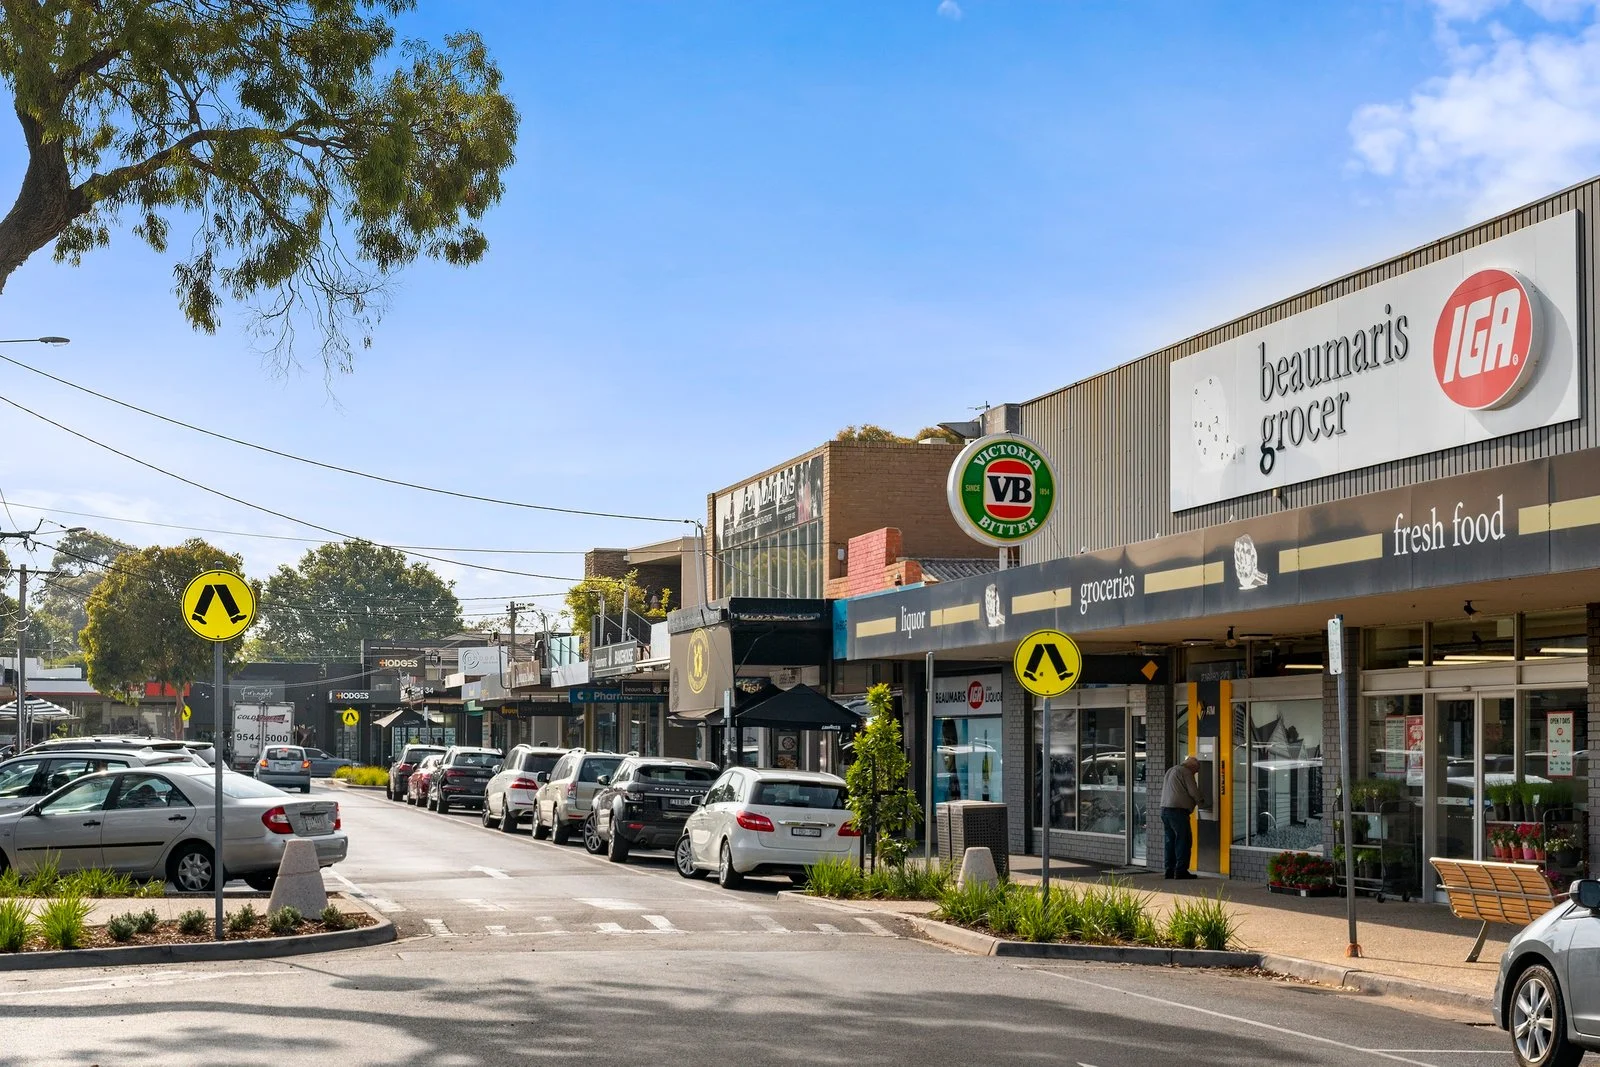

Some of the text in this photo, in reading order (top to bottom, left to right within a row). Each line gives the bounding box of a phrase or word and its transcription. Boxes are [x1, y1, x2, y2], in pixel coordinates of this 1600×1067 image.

[1443, 288, 1521, 384] IGA
[1258, 303, 1409, 403] beaumaris
[1260, 391, 1350, 476] grocer
[974, 445, 1041, 470] VICTORIA
[987, 476, 1032, 503] VB
[978, 516, 1038, 535] BITTER
[1393, 495, 1506, 556] fresh food
[1080, 569, 1135, 615] groceries
[901, 606, 926, 639] liquor
[935, 691, 966, 703] BEAUMARIS
[236, 733, 261, 741] 9544
